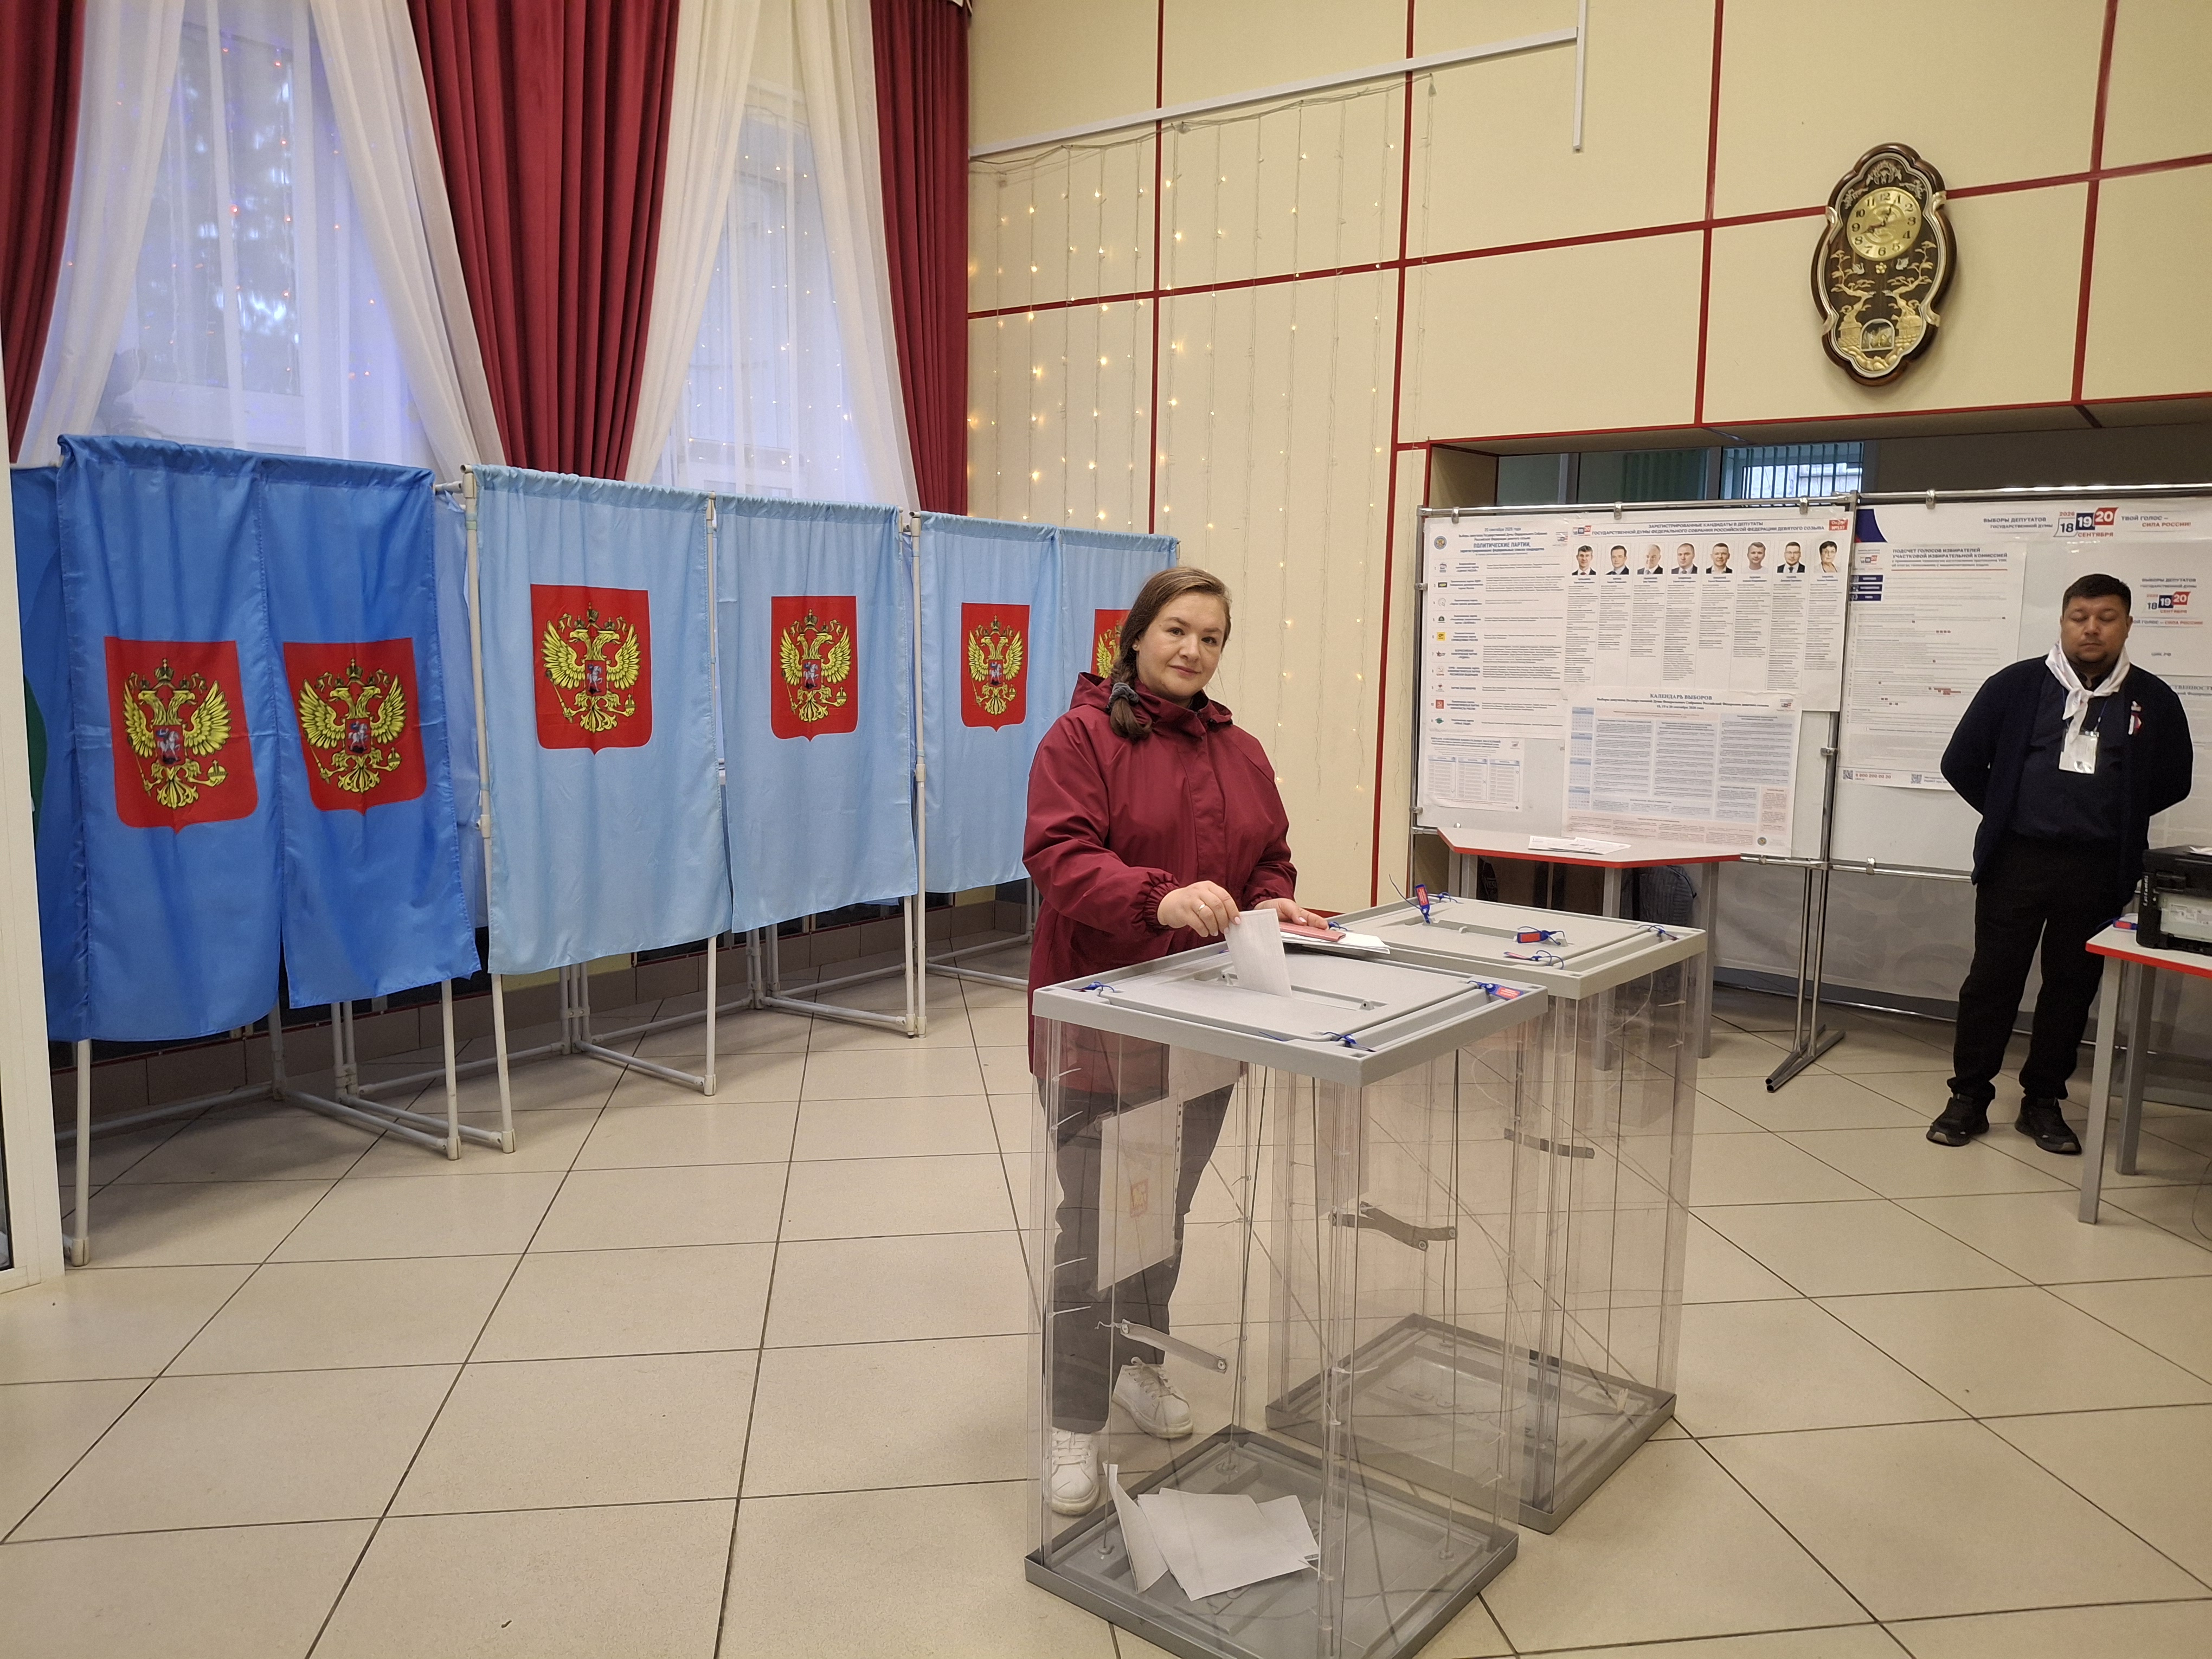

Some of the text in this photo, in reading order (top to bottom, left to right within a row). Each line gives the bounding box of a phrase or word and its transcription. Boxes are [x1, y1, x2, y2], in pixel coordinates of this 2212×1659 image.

[1880, 192, 1891, 201] 12
[1898, 195, 1901, 204] 1
[1867, 197, 1875, 207] 11
[1905, 203, 1914, 212] 2
[1856, 209, 1866, 217] 10
[1907, 217, 1917, 226] 3
[1851, 223, 1861, 232] 9
[1902, 230, 1911, 239] 4
[1854, 236, 1863, 245] 8
[1864, 245, 1873, 254] 7
[1878, 247, 1886, 256] 6
[1892, 242, 1900, 252] 5
[2095, 511, 2113, 522] 20
[2078, 516, 2092, 528] 19
[2060, 523, 2074, 532] 18
[2160, 597, 2171, 606] 19
[2173, 594, 2187, 603] 20
